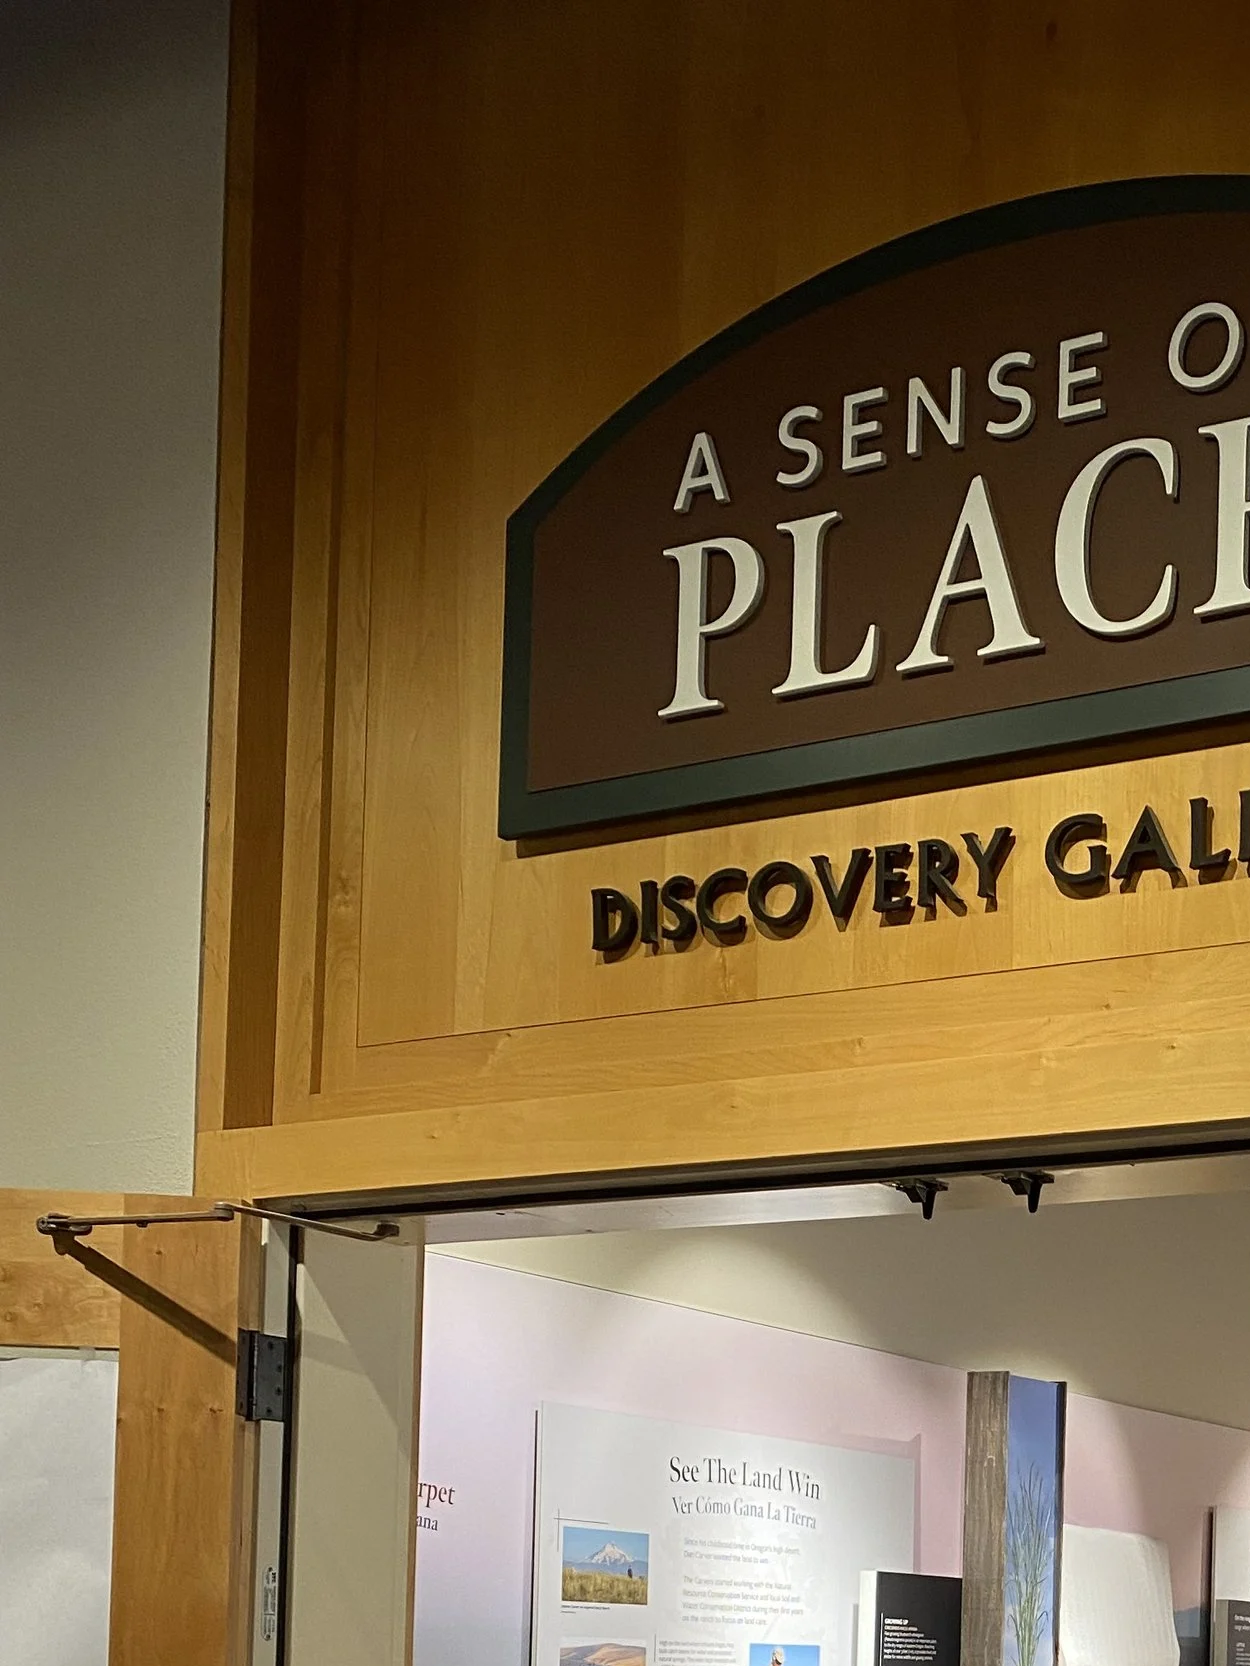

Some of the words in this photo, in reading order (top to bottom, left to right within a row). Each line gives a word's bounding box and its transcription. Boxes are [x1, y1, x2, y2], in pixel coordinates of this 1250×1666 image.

[674, 432, 730, 512] A
[776, 331, 1109, 489] SENSE
[590, 826, 1016, 955] DISCOVERY
[669, 1456, 700, 1483] See
[703, 1458, 737, 1485] The
[742, 1461, 782, 1491] Land
[788, 1468, 821, 1500] Win
[672, 1496, 693, 1514] Ver
[696, 1495, 731, 1515] Cómo
[733, 1497, 764, 1519] Gana
[767, 1501, 781, 1521] La
[784, 1505, 817, 1529] Tierra
